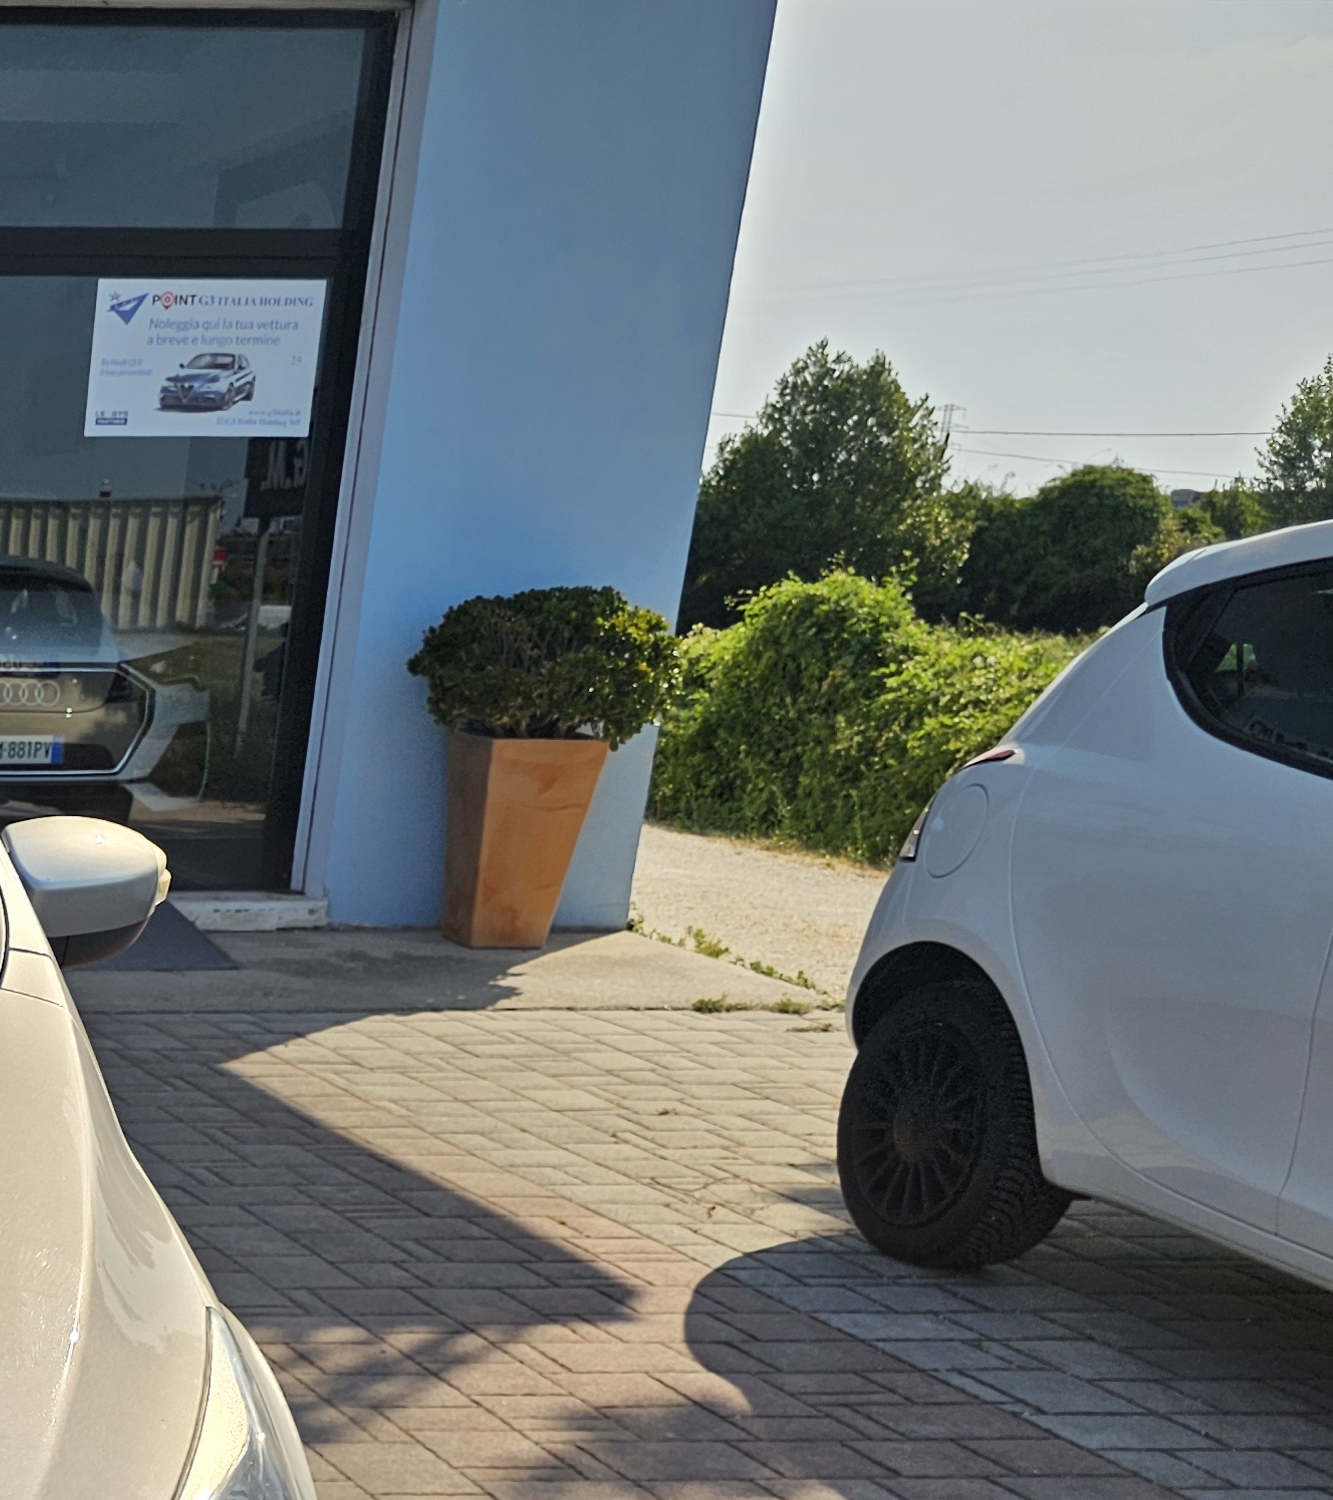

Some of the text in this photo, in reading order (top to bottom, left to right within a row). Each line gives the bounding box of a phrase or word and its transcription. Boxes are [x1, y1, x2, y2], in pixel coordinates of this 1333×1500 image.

[218, 296, 256, 307] ITALIA
[259, 296, 313, 307] HOLDING
[148, 318, 299, 332] Noleggia qui la tua vettura
[156, 334, 190, 346] breve
[192, 337, 199, 346] e
[201, 334, 233, 348] lungo
[236, 334, 281, 346] termine
